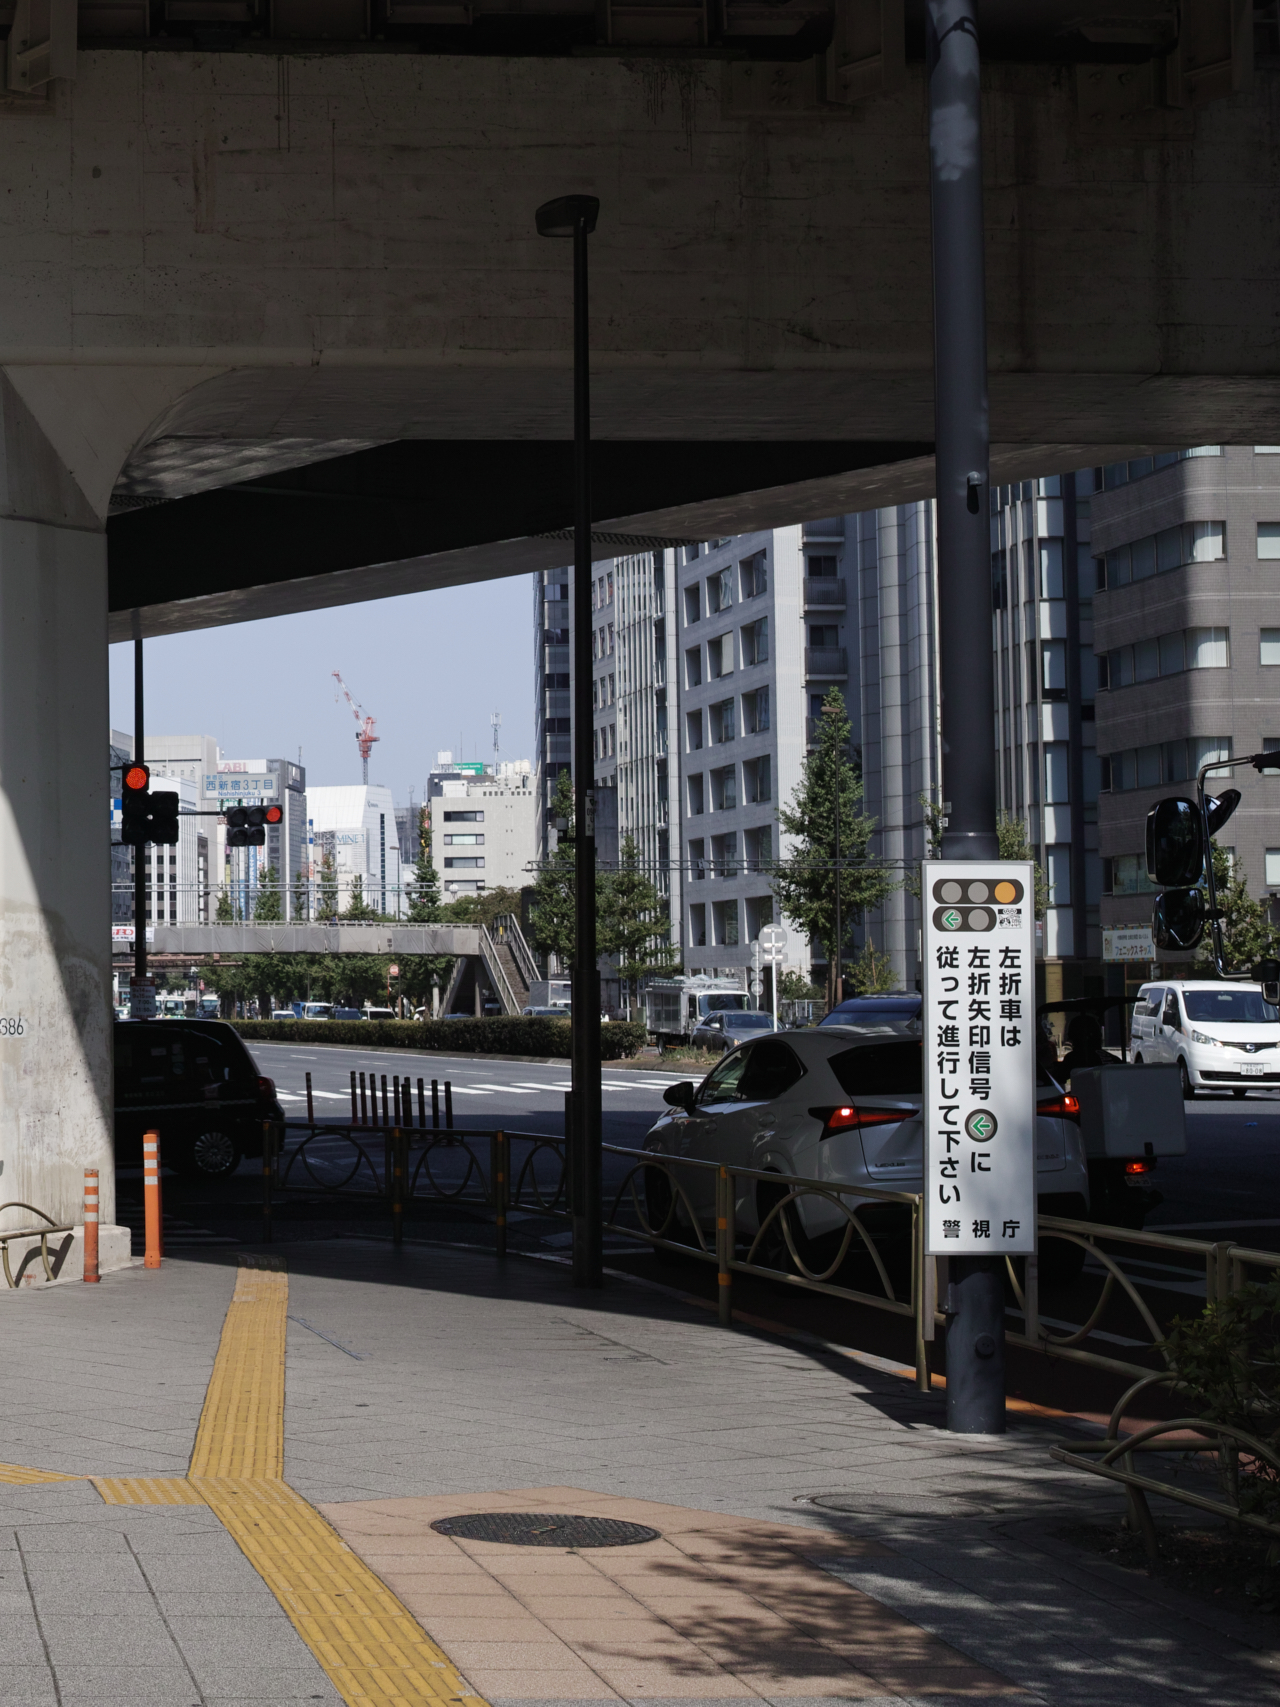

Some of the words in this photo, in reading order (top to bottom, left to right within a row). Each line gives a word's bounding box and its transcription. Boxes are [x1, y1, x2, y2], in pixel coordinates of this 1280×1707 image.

[216, 762, 247, 773] LABI
[206, 779, 273, 791] 西新宿3丁目
[218, 790, 255, 798] Nishishinjuku
[999, 946, 1022, 1048] 左折車は
[968, 946, 992, 1101] 左折矢印信号
[936, 946, 962, 1205] 従って進行して下さい
[942, 1218, 1021, 1240] 警視庁
